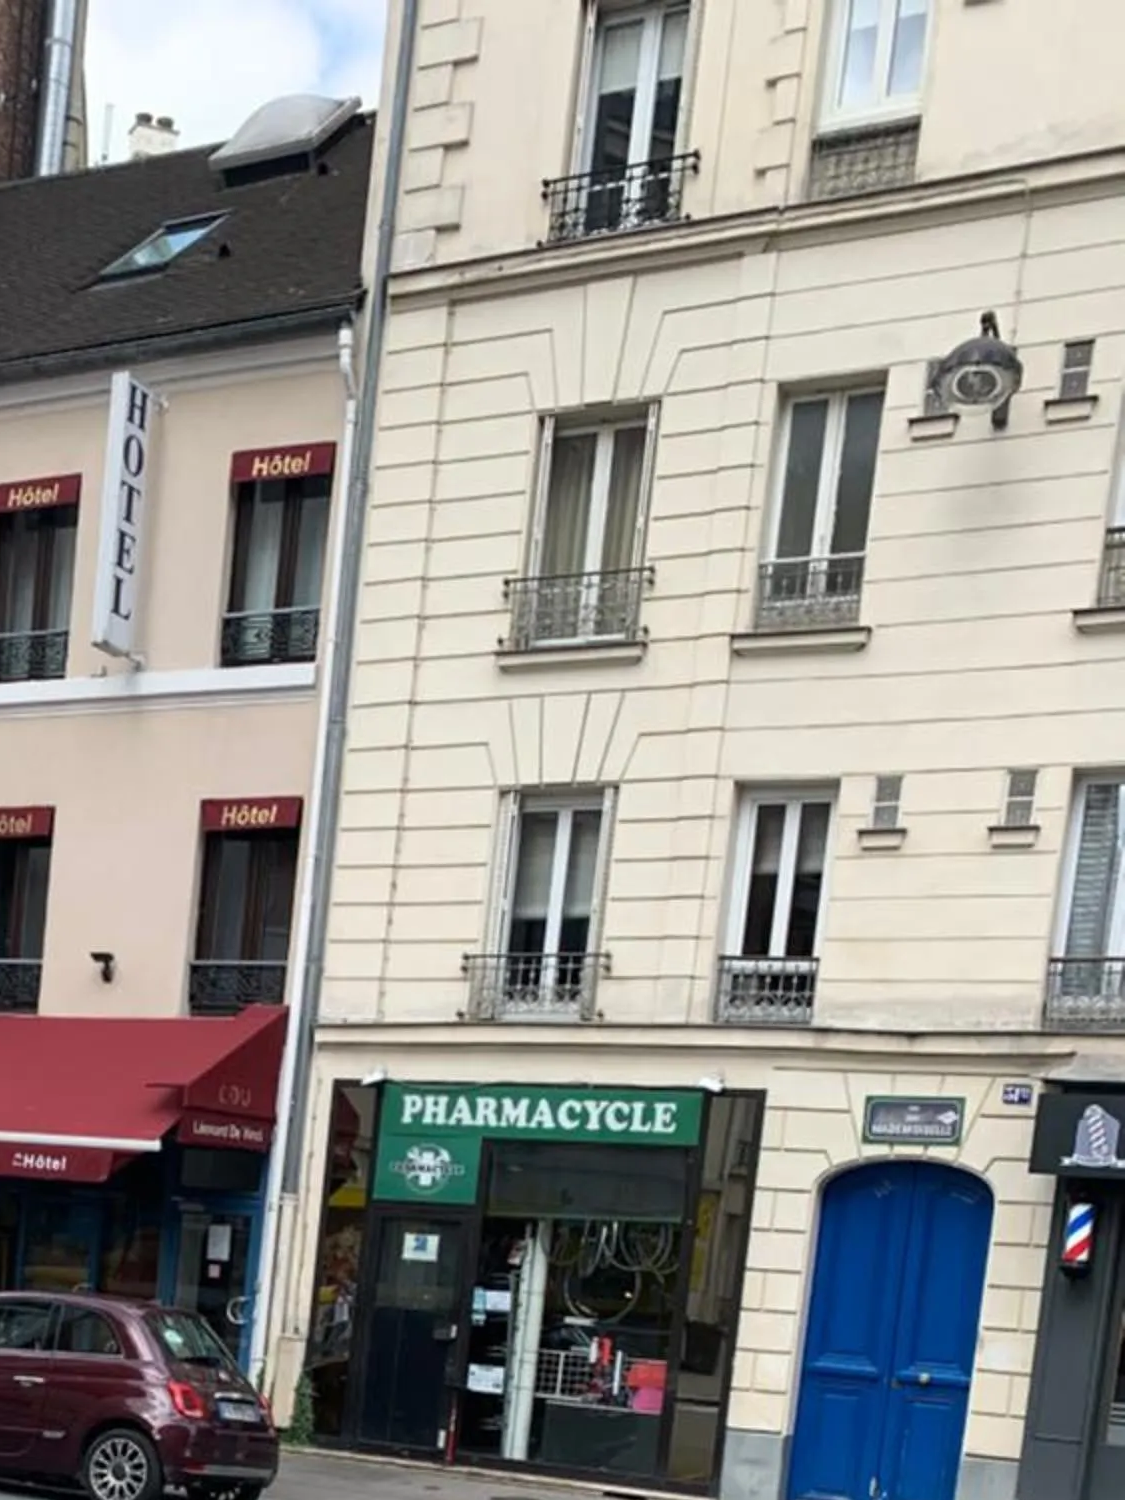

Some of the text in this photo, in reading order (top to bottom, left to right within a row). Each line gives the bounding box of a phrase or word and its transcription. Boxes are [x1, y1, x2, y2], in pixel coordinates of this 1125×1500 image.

[252, 451, 311, 477] Hôtel
[7, 483, 60, 508] Hôtel
[110, 383, 150, 621] HOTEL
[220, 804, 278, 826] Hôtel
[401, 1094, 678, 1134] PHARMACYCLE
[22, 1152, 67, 1172] Hôtel
